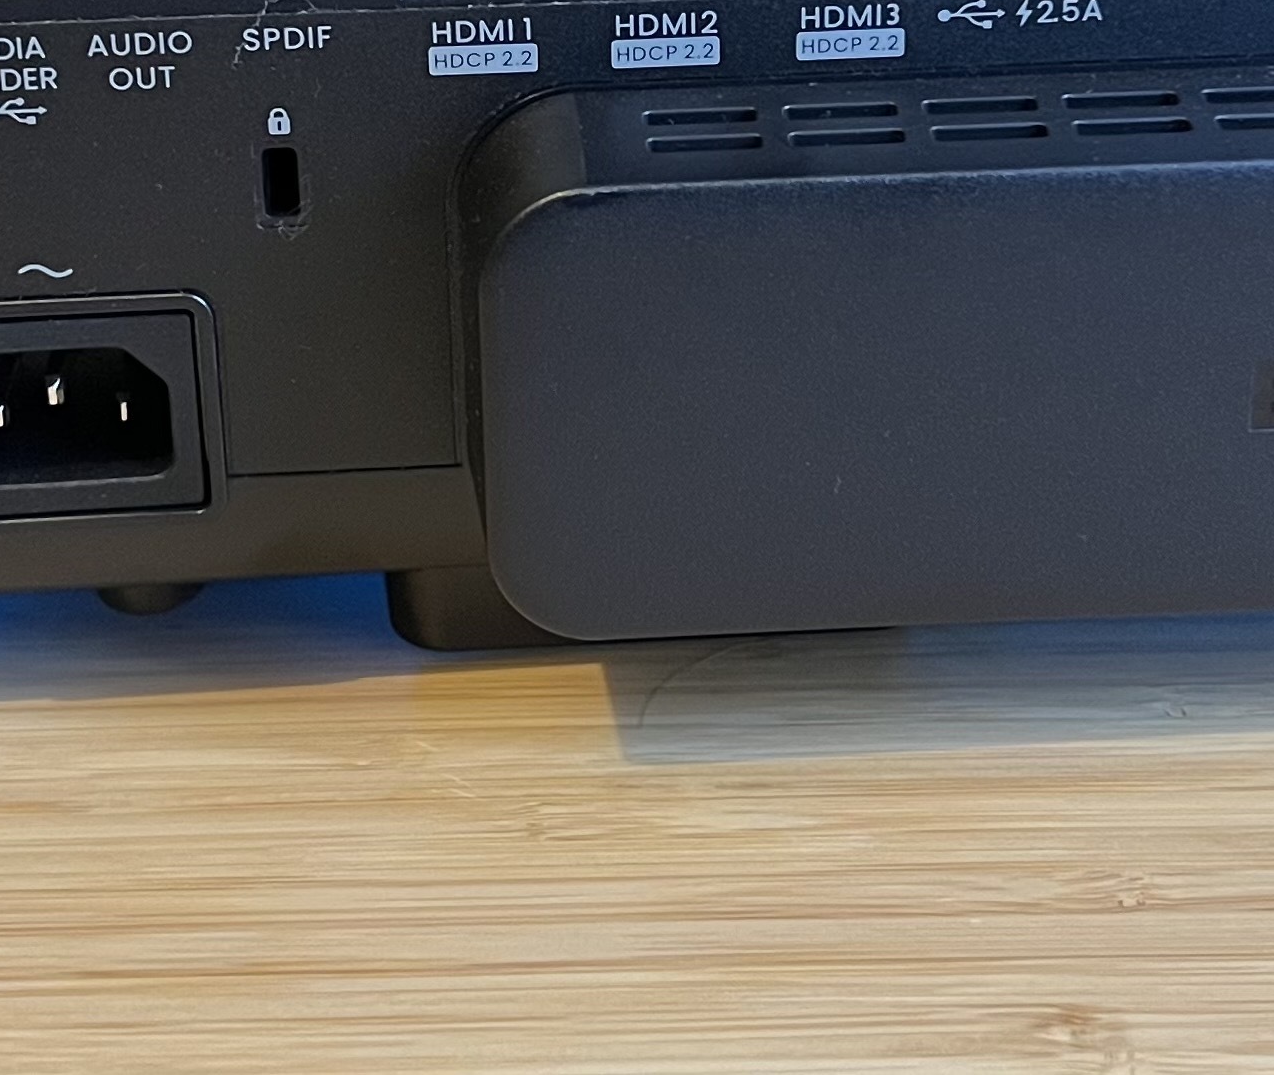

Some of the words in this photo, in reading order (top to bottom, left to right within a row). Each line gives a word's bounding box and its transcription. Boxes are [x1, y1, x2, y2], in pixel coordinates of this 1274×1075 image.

[614, 10, 719, 39] HDMI2
[799, 3, 902, 31] HDMI3
[87, 31, 193, 57] AUDIO
[240, 24, 333, 53] SPDIF
[800, 36, 862, 55] HDCP
[866, 33, 900, 53] 2.2
[433, 51, 495, 70] HDCP
[501, 49, 534, 68] 2.2
[616, 44, 678, 63] HDCP
[683, 42, 716, 61] 2.2
[109, 65, 176, 91] OUT
